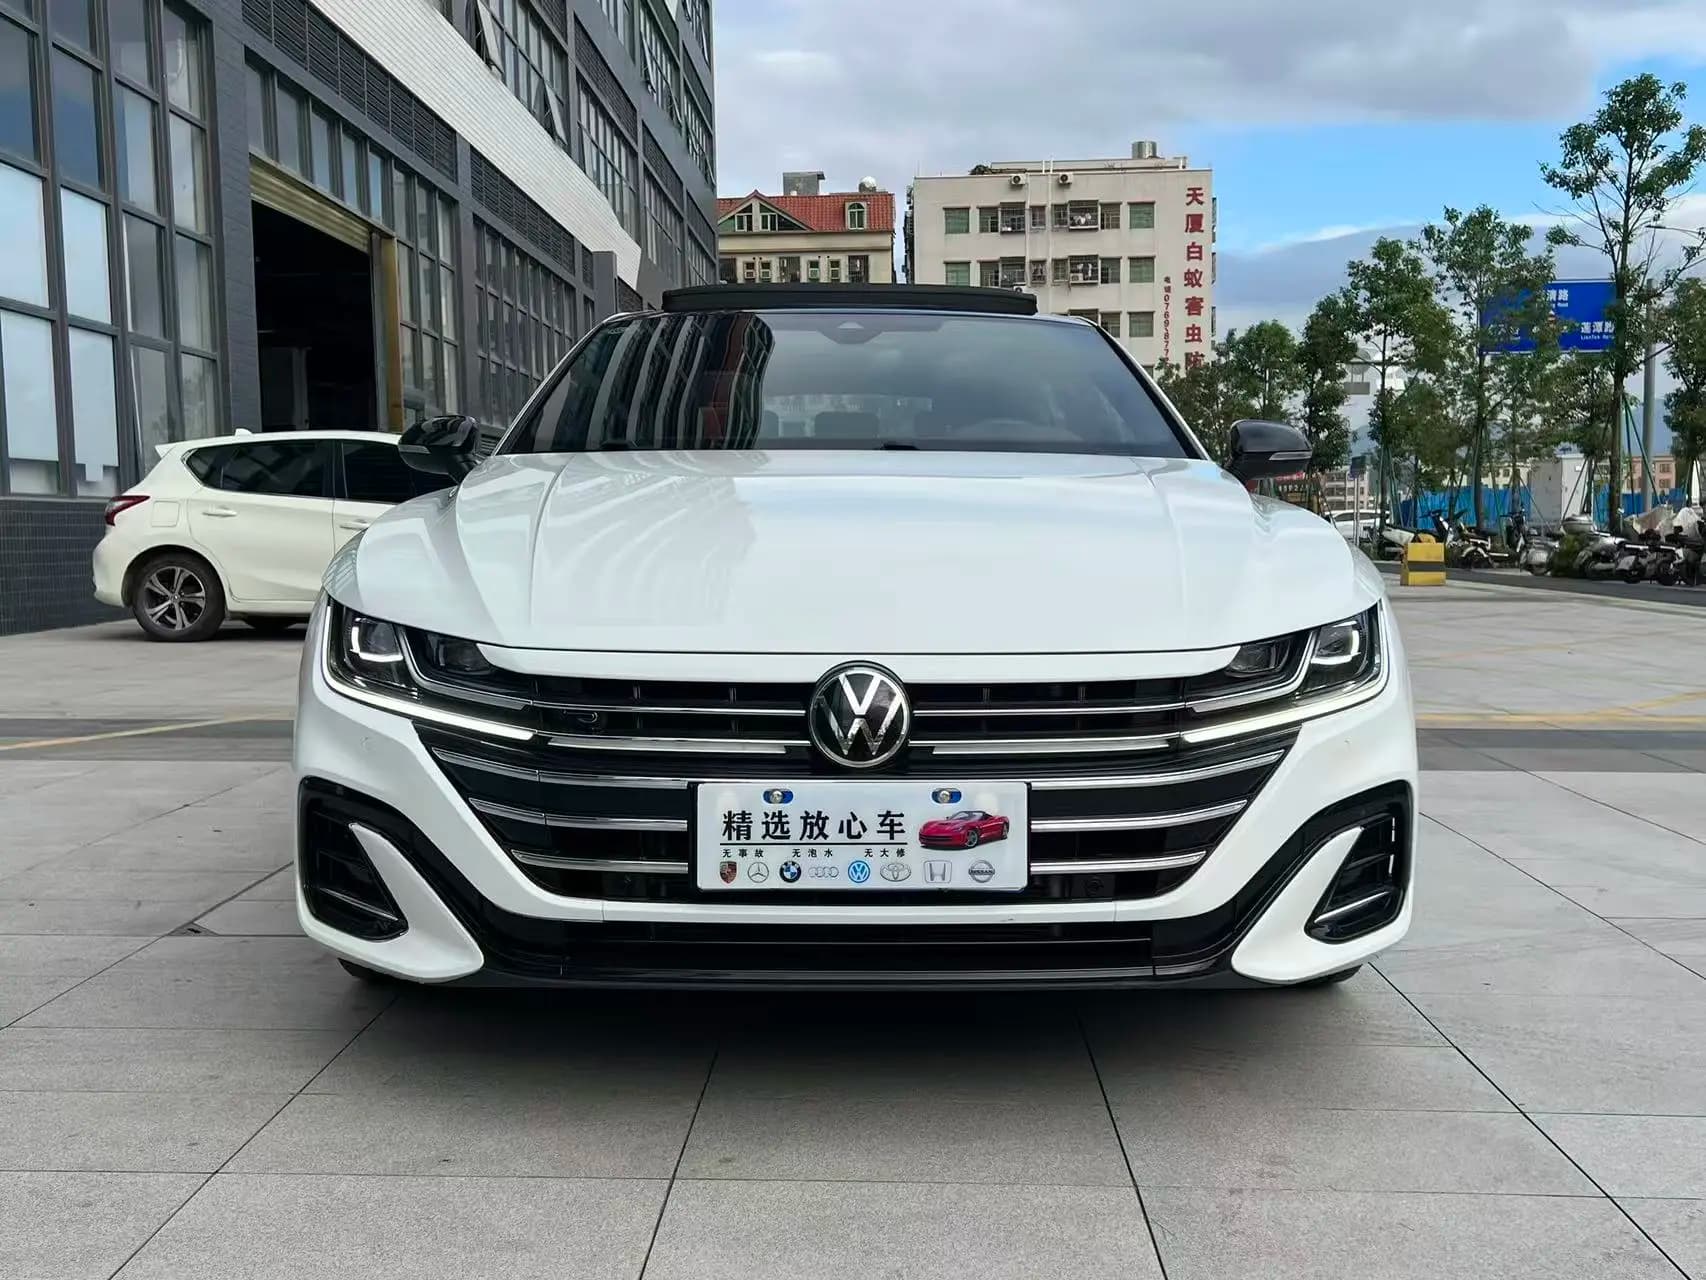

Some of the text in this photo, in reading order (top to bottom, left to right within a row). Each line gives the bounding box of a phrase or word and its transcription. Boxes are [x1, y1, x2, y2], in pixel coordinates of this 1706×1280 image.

[722, 810, 905, 841] 精选放心车
[722, 848, 906, 858] 无事故 无泡水 无大修
